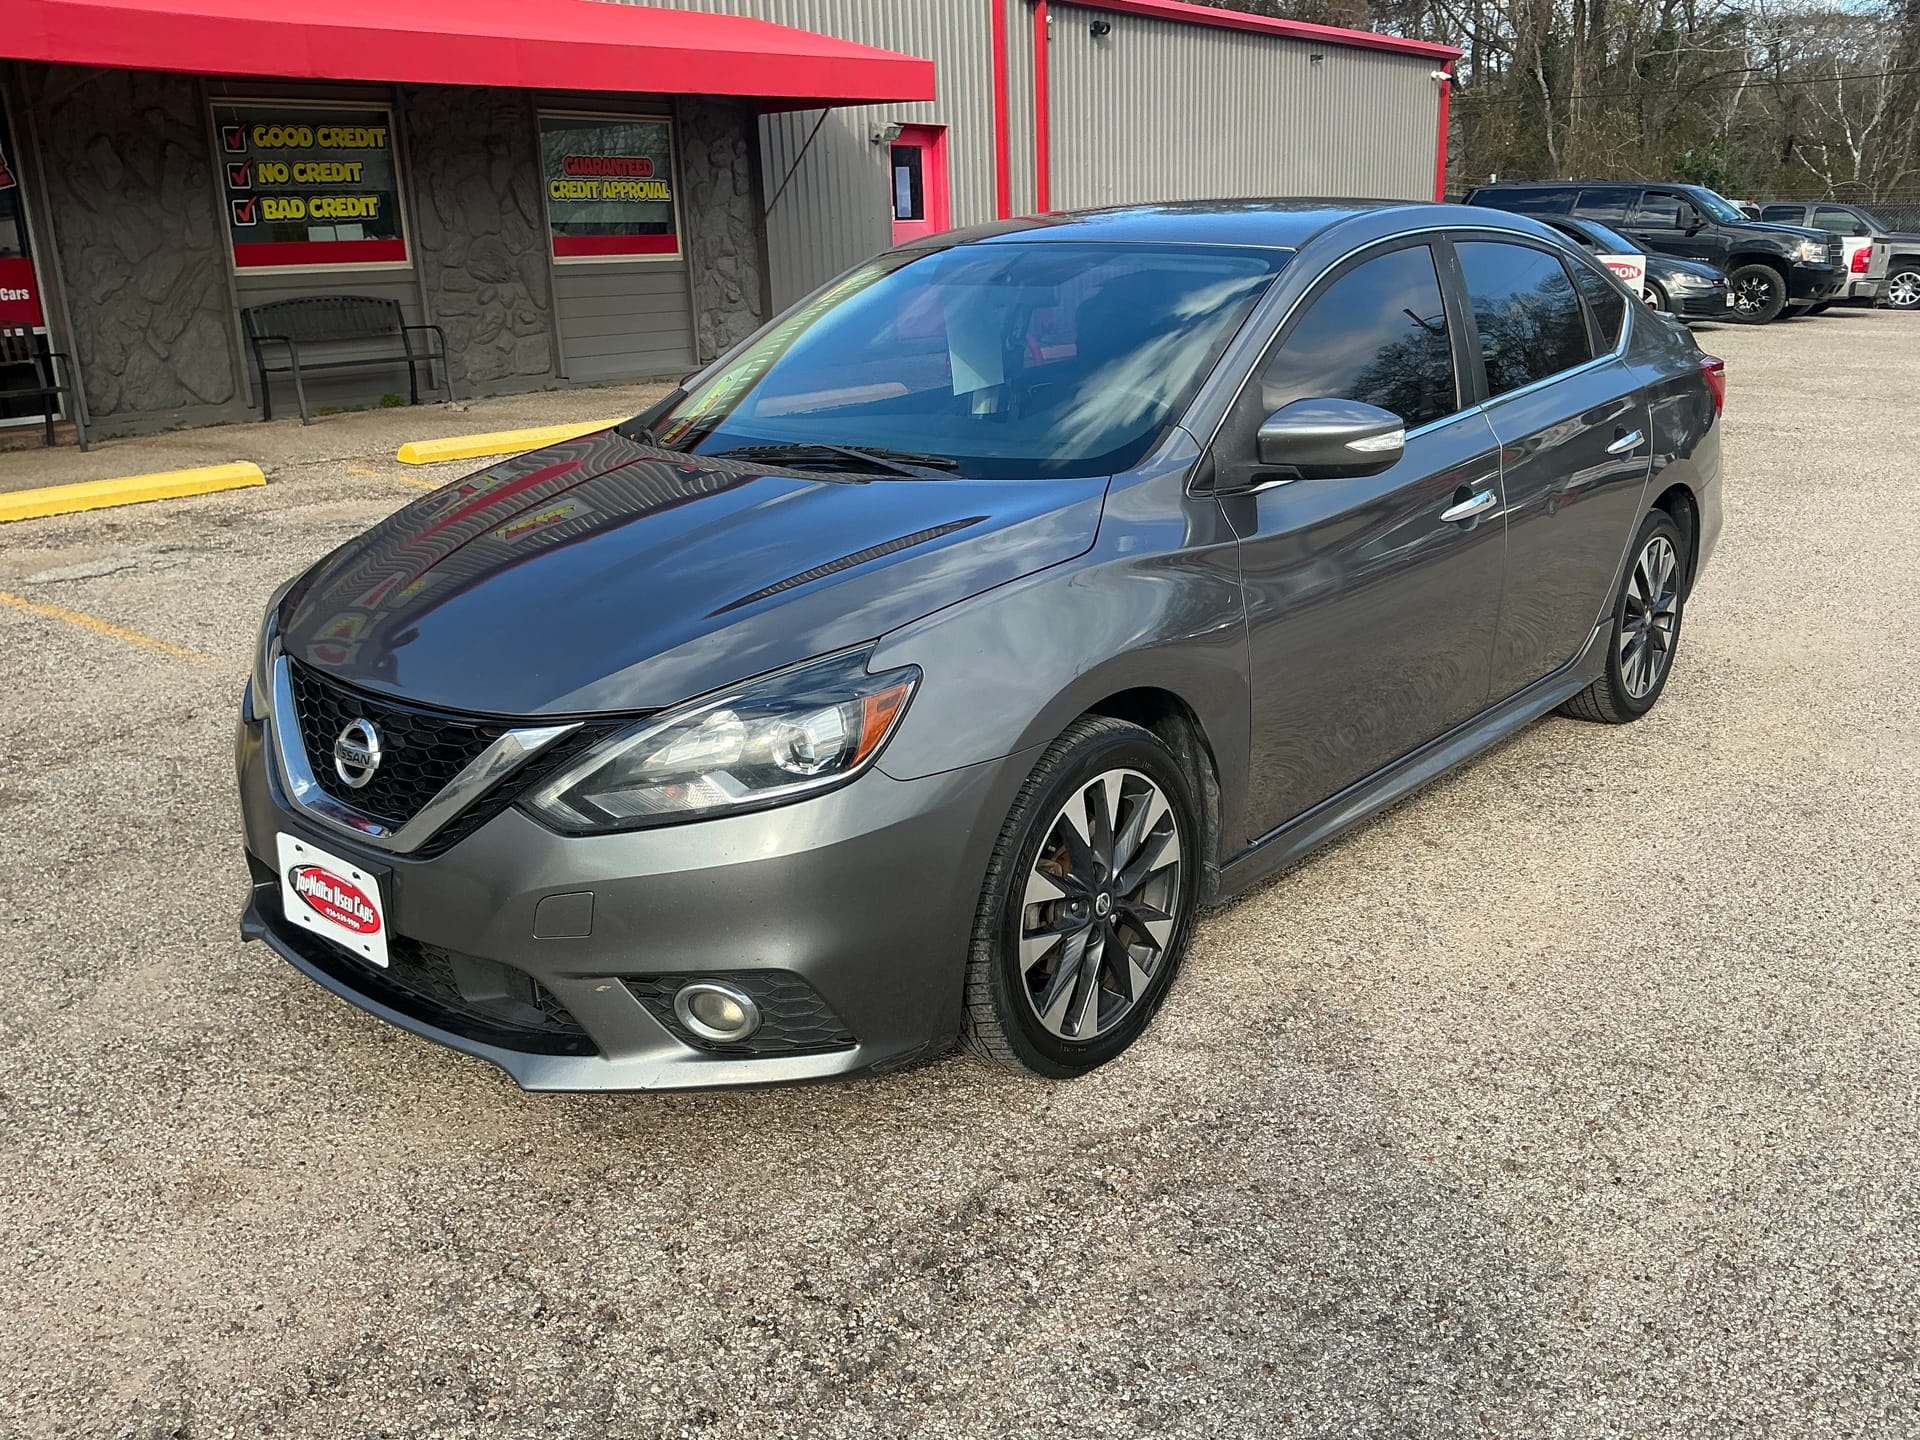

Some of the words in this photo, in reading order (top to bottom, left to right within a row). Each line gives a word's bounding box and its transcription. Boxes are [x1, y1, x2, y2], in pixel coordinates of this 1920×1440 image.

[253, 126, 314, 148] GOOD
[316, 127, 386, 149] CREDIT
[258, 162, 290, 184] NO
[292, 162, 363, 184] CREDIT
[564, 156, 654, 177] GUARANTEED
[550, 180, 600, 200] CREDIT
[601, 180, 671, 200] APPROVAL
[262, 198, 306, 220] BAD
[309, 196, 378, 219] CREDIT
[0, 288, 30, 301] Cars
[353, 895, 374, 924] CARS
